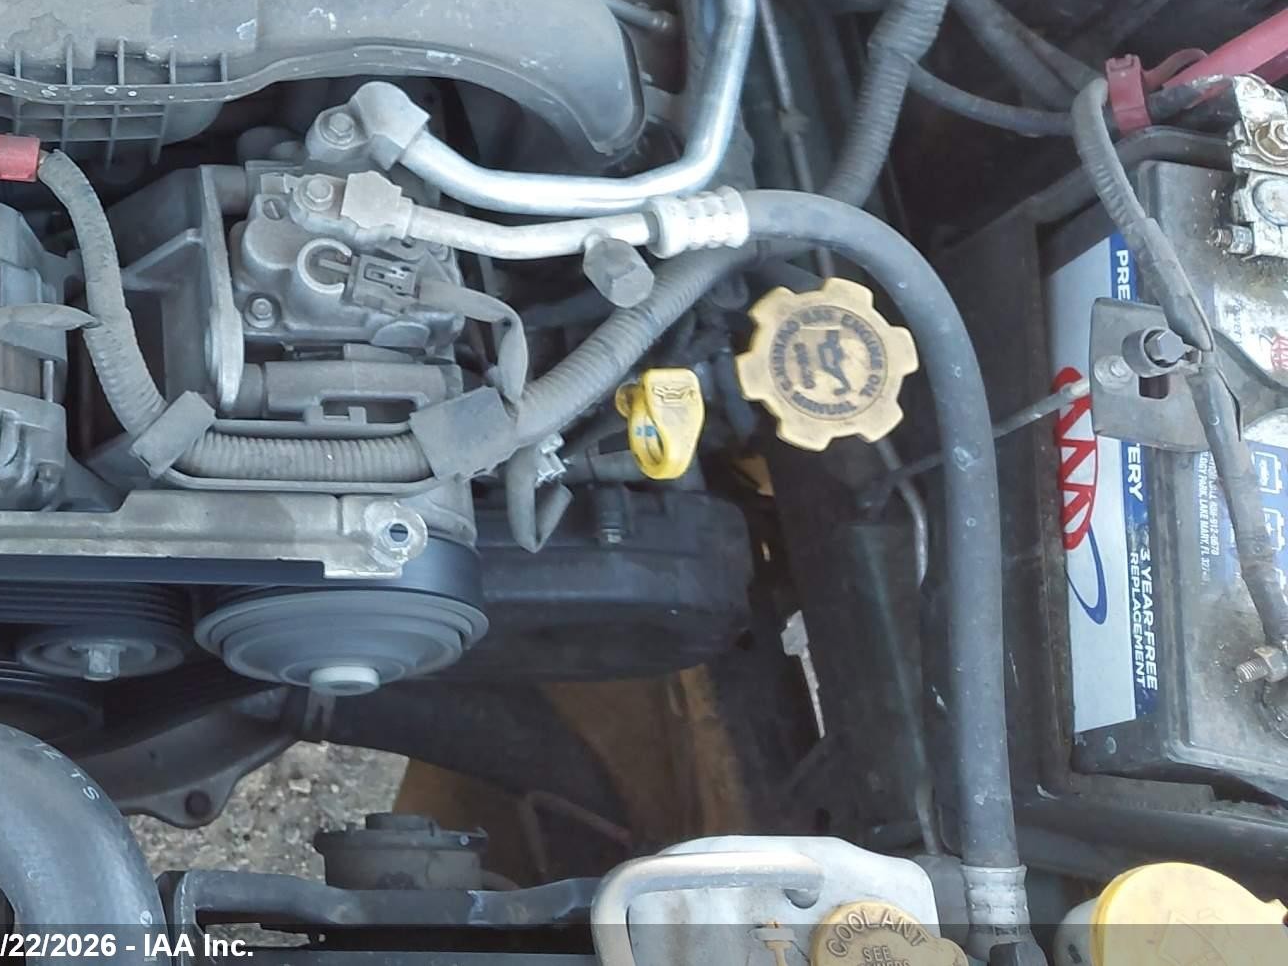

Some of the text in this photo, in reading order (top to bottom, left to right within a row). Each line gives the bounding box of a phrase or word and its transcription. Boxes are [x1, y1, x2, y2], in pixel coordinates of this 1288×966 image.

[1116, 249, 1144, 502] PRE ERY
[1140, 547, 1151, 562] 3
[1130, 552, 1146, 687] REPLACEMENT
[827, 908, 929, 957] COOLANT
[862, 945, 892, 963] SEE
